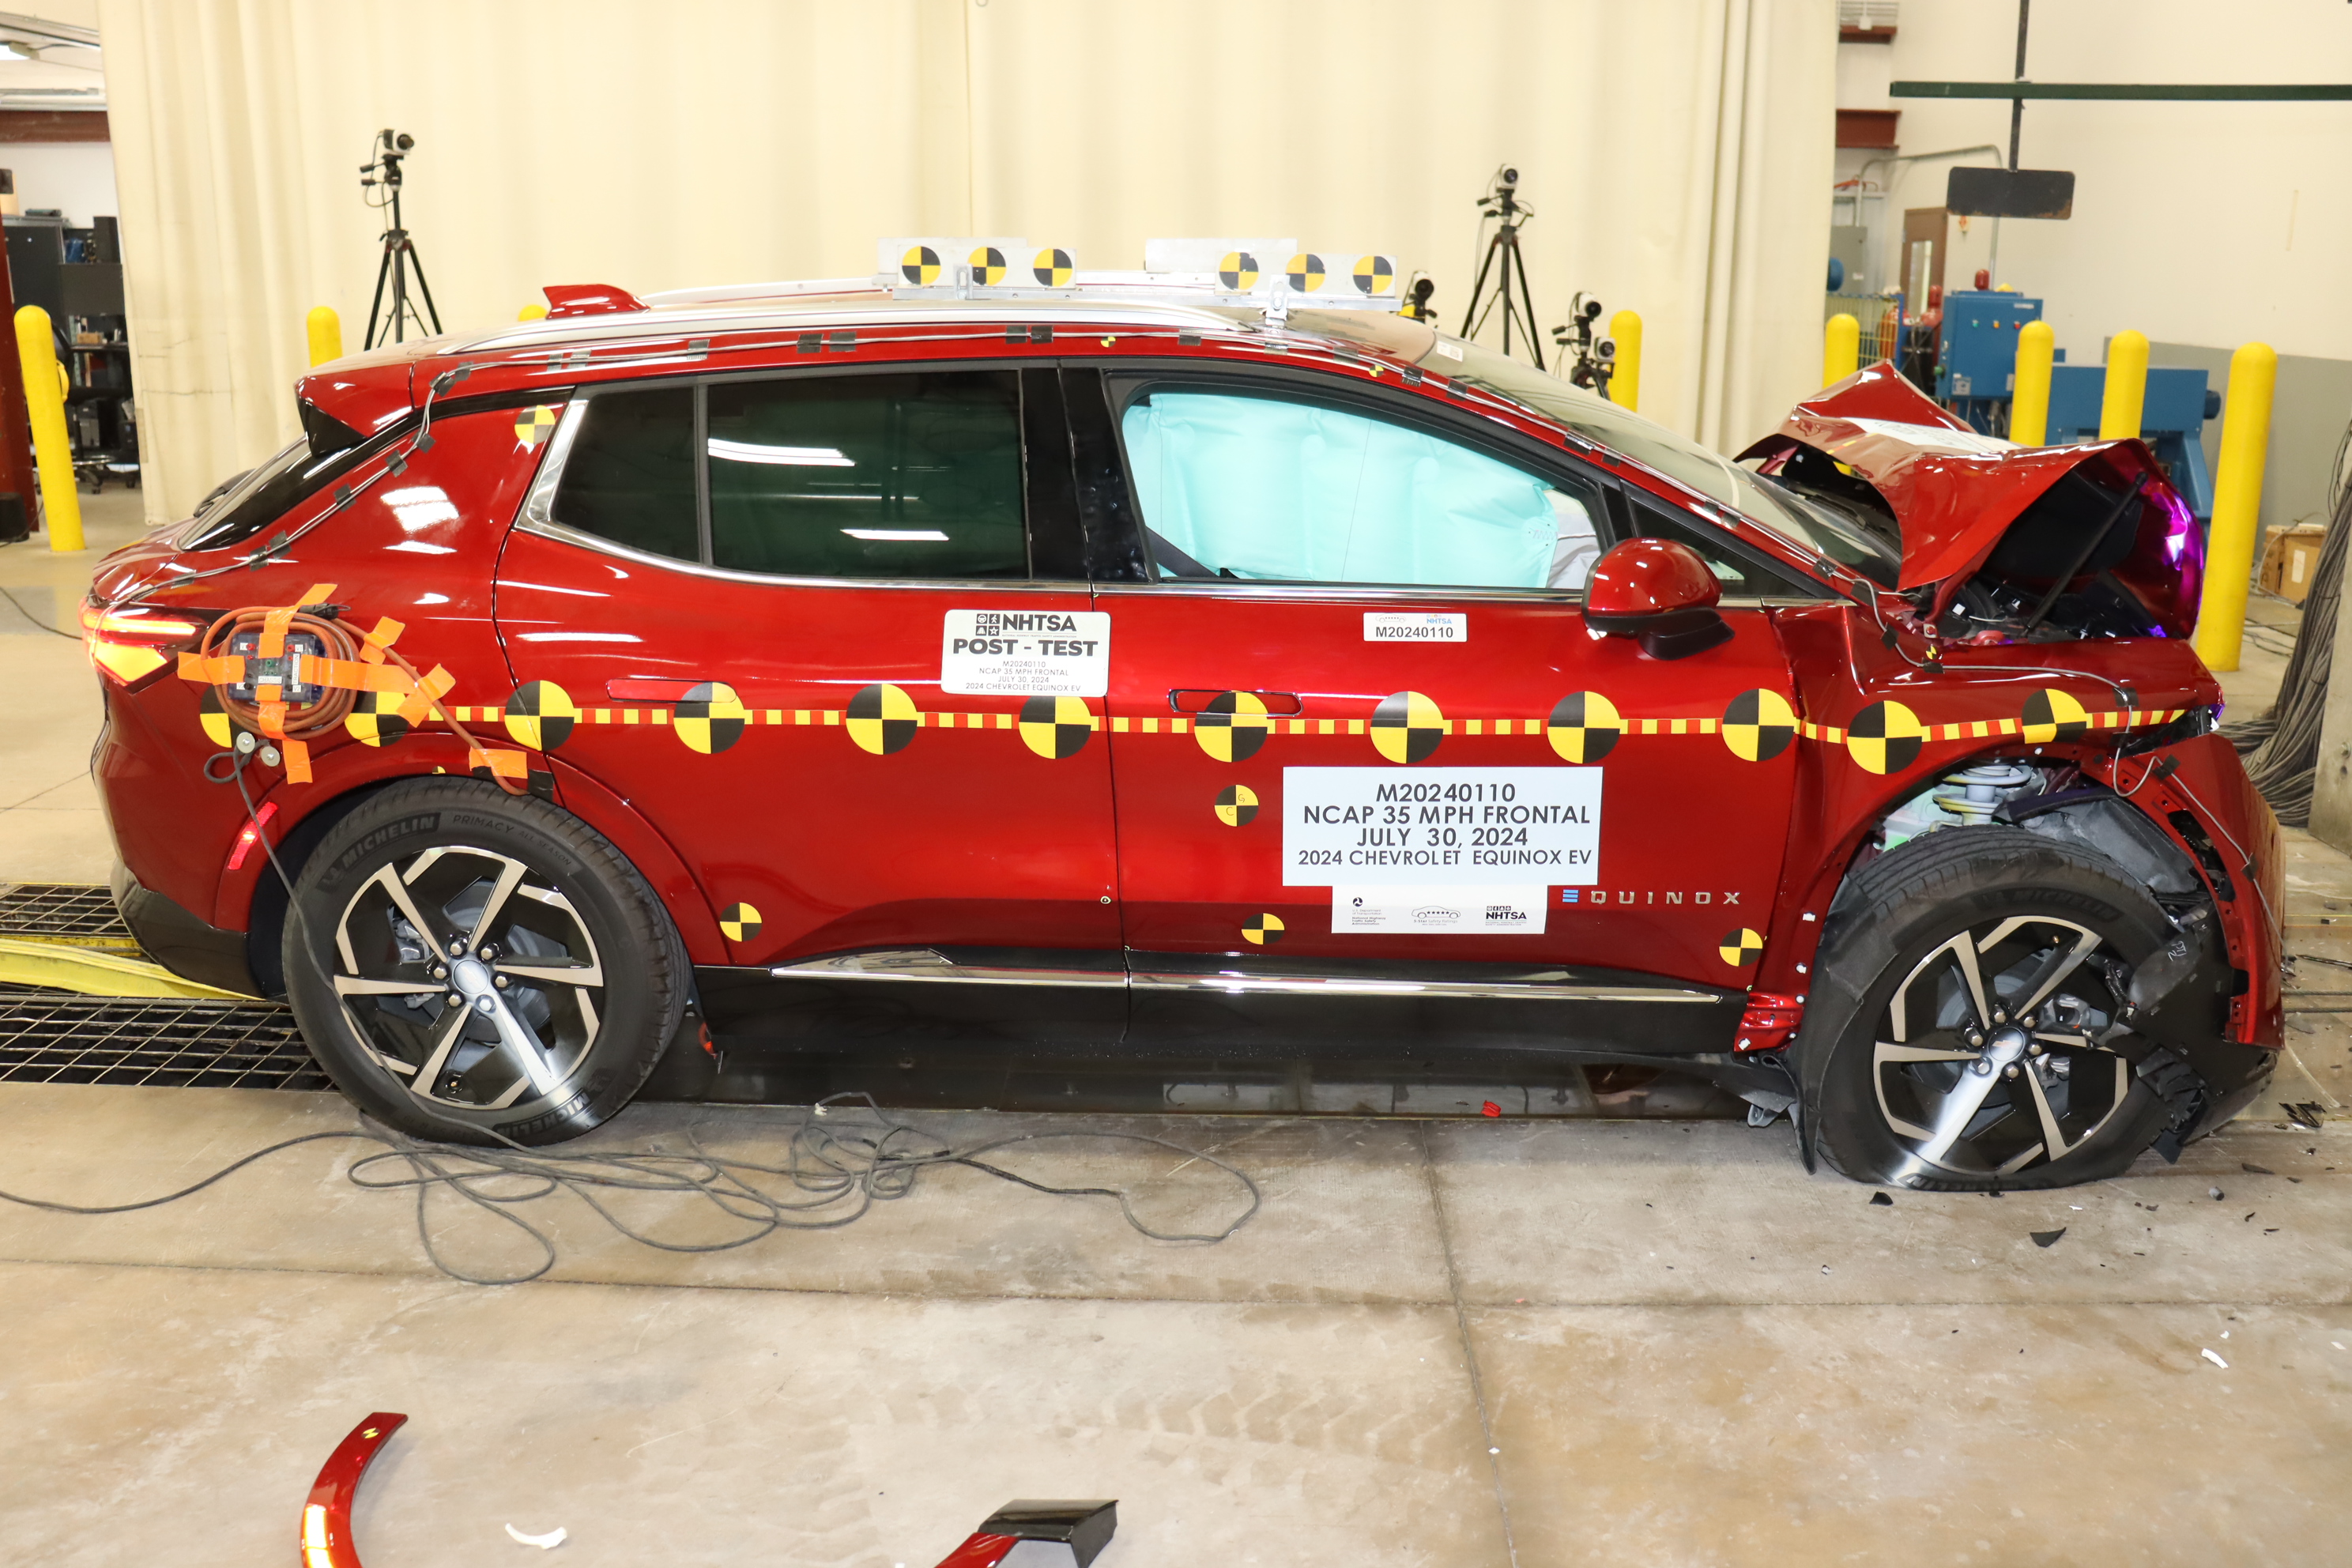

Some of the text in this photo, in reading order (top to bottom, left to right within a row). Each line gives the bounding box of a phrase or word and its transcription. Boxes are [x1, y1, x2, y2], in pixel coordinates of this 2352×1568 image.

[1003, 614, 1076, 631] NHTSA
[1376, 627, 1453, 638] M20240110
[953, 639, 1018, 654] POST
[1038, 640, 1098, 656] TEST
[1376, 783, 1515, 802] M20240110
[1305, 805, 1589, 824] NCAP 35 MPH FRONTAL
[342, 815, 572, 867] MICHELIN PRIMACY ALL SEASON
[1357, 827, 1528, 848] JULY 30, 2024
[1298, 850, 1591, 865] 2024 CHEVROLET EQUINOX EV
[2012, 891, 2118, 919] MICHELIN
[496, 1091, 590, 1139] MICHELIN
